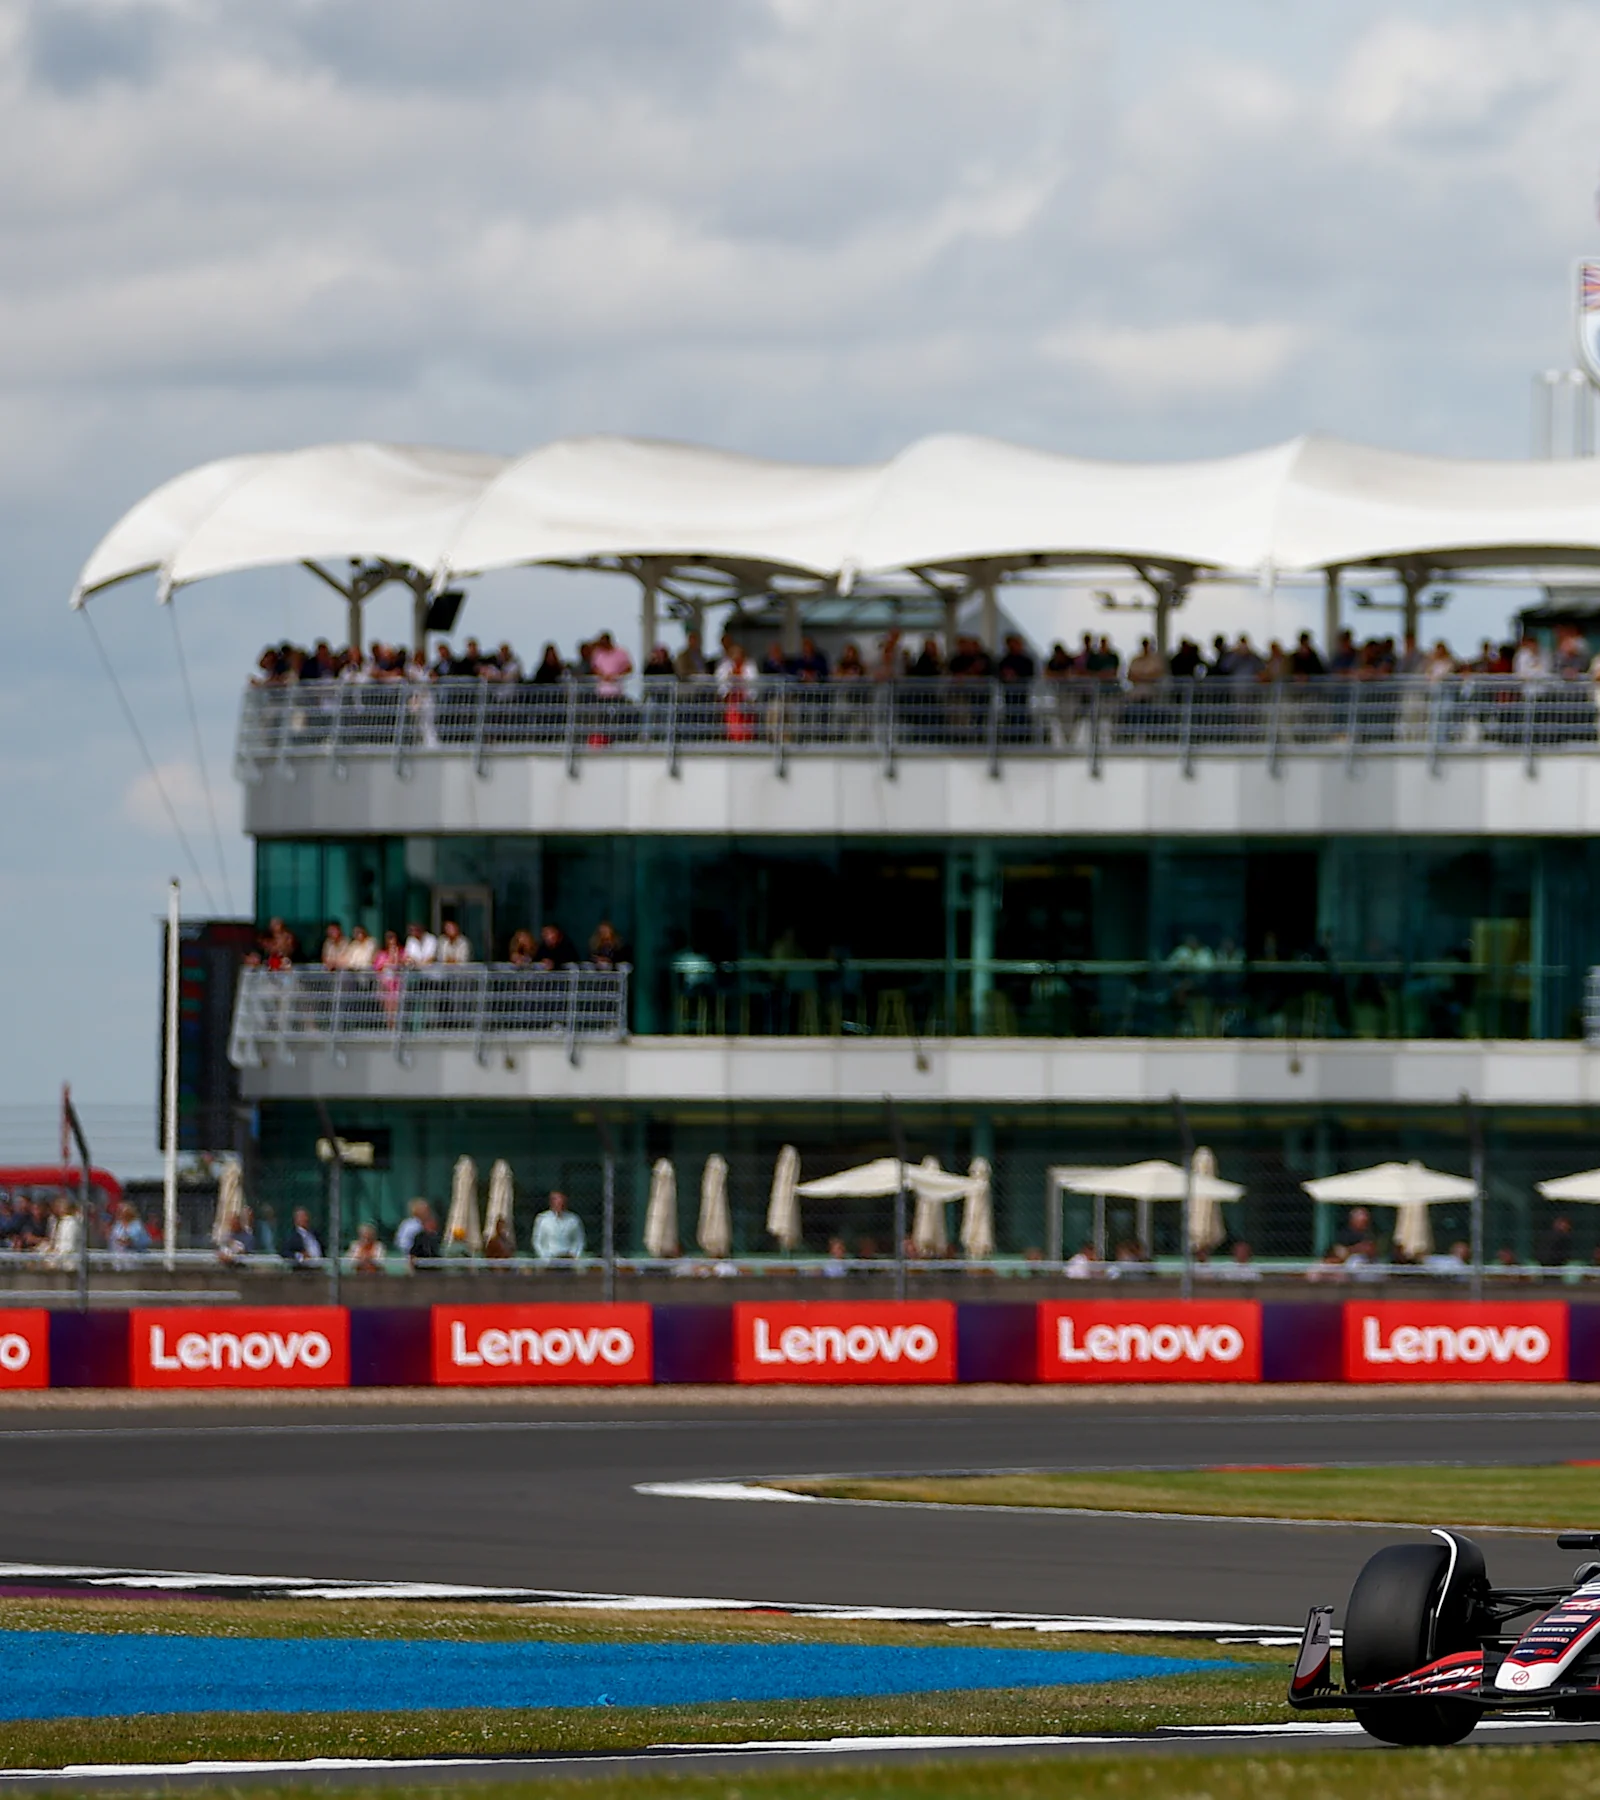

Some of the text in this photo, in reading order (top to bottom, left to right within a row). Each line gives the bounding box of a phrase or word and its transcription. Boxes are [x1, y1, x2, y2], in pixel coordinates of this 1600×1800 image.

[150, 1325, 332, 1370] Lenovo
[451, 1321, 634, 1366] Lenovo
[754, 1318, 938, 1364] Lenovo
[1058, 1318, 1244, 1362] Lenovo
[1363, 1317, 1549, 1363] Lenovo
